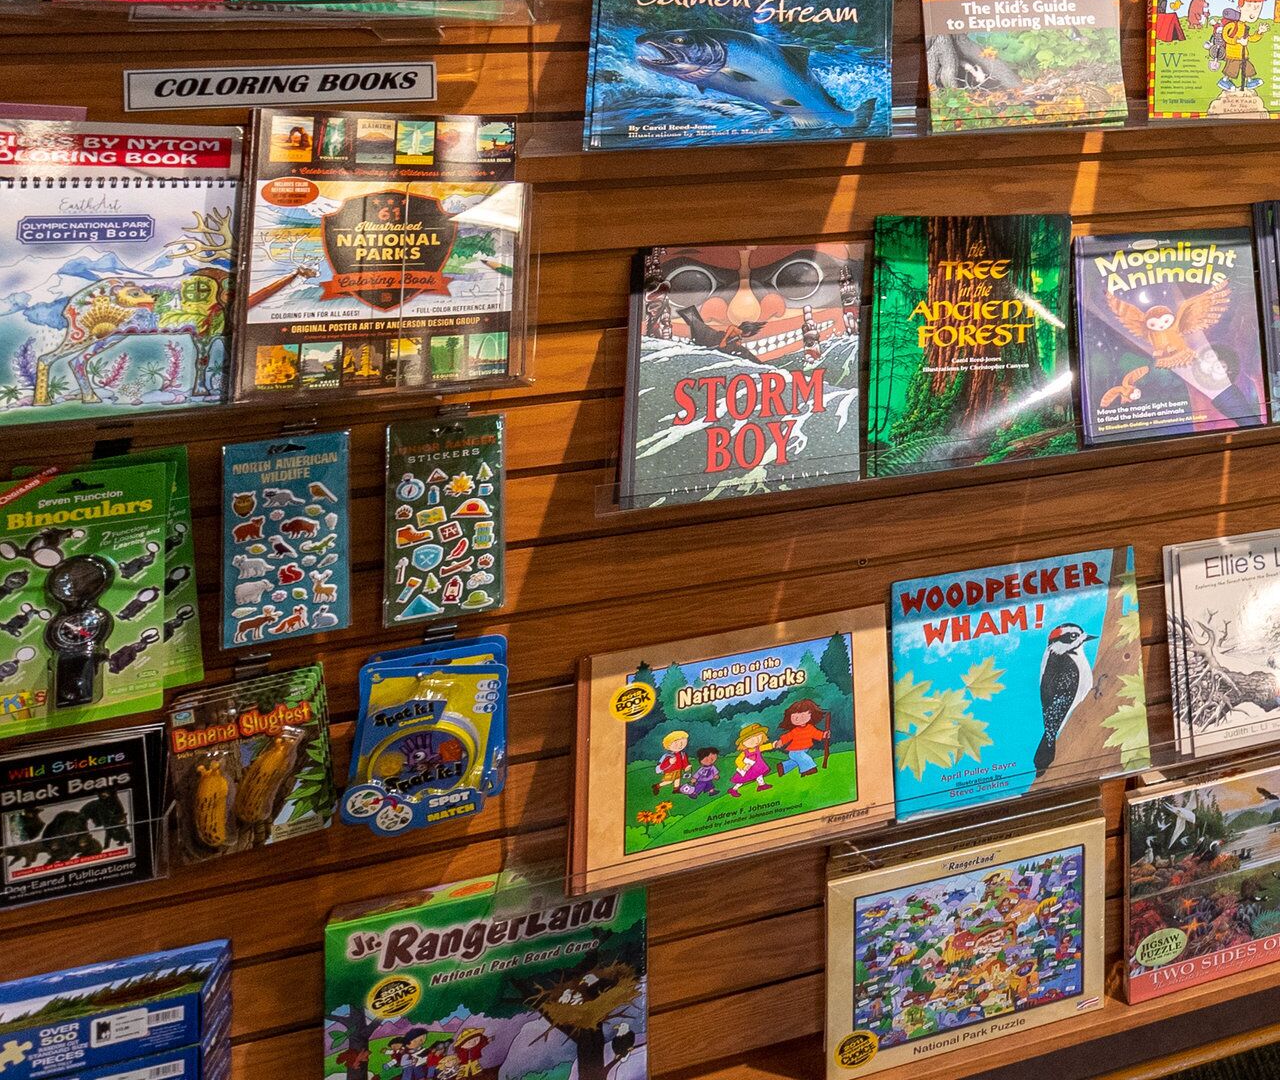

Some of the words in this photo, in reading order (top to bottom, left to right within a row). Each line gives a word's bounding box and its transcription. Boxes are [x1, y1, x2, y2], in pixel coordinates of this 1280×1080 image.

[961, 1, 990, 15] The
[994, 0, 1028, 14] Kid's
[1032, 0, 1076, 13] Guide
[947, 18, 964, 30] to
[968, 15, 1039, 32] Exploring
[1044, 13, 1096, 27] Nature
[154, 74, 310, 99] COLORING
[317, 71, 418, 94] BOOKS
[22, 222, 67, 230] OLYMPIC
[23, 229, 99, 240] Coloring
[106, 229, 147, 238] Book
[336, 233, 441, 247] NATIONAL
[967, 240, 987, 258] the
[355, 246, 421, 261] PARKS
[1094, 241, 1237, 277] Moonlight
[939, 259, 1012, 282] TREE
[1106, 261, 1227, 296] Animals
[974, 282, 992, 298] the
[908, 298, 1038, 323] ANCIENT
[917, 323, 1036, 349] FOREST
[674, 368, 826, 427] STORM
[407, 448, 481, 464] STICKERS
[704, 420, 797, 474] BOY
[232, 462, 273, 476] NORTH
[275, 452, 338, 472] AMERICAN
[260, 466, 310, 482] WILDLIFE
[6, 496, 153, 531] Binoculars
[1204, 552, 1266, 578] Ellie's
[900, 561, 1105, 616] WOODPECKER
[923, 604, 1045, 647] WHAM!
[731, 661, 747, 675] Us
[749, 660, 760, 672] at
[763, 656, 781, 670] the
[677, 676, 752, 710] National
[756, 668, 806, 692] Parks
[172, 725, 237, 753] Banana
[240, 703, 312, 739] Slugfest
[52, 751, 125, 773] Stickers
[2, 784, 60, 806] Black
[68, 772, 131, 794] Bears
[429, 791, 470, 808] SPOT
[427, 803, 475, 822] MATCH
[351, 935, 382, 957] Jr.
[382, 894, 618, 969] RangerLand
[431, 964, 486, 986] National
[490, 958, 518, 971] Park
[524, 948, 560, 963] Board
[565, 939, 599, 954] Game
[1149, 961, 1198, 984] TWO
[1200, 944, 1257, 969] SIDES
[39, 1022, 80, 1038] OVER
[40, 1032, 78, 1046] 500
[913, 1036, 961, 1055] National
[963, 1027, 988, 1044] Park
[990, 1017, 1026, 1036] Puzzle
[32, 1050, 85, 1068] PIECES
